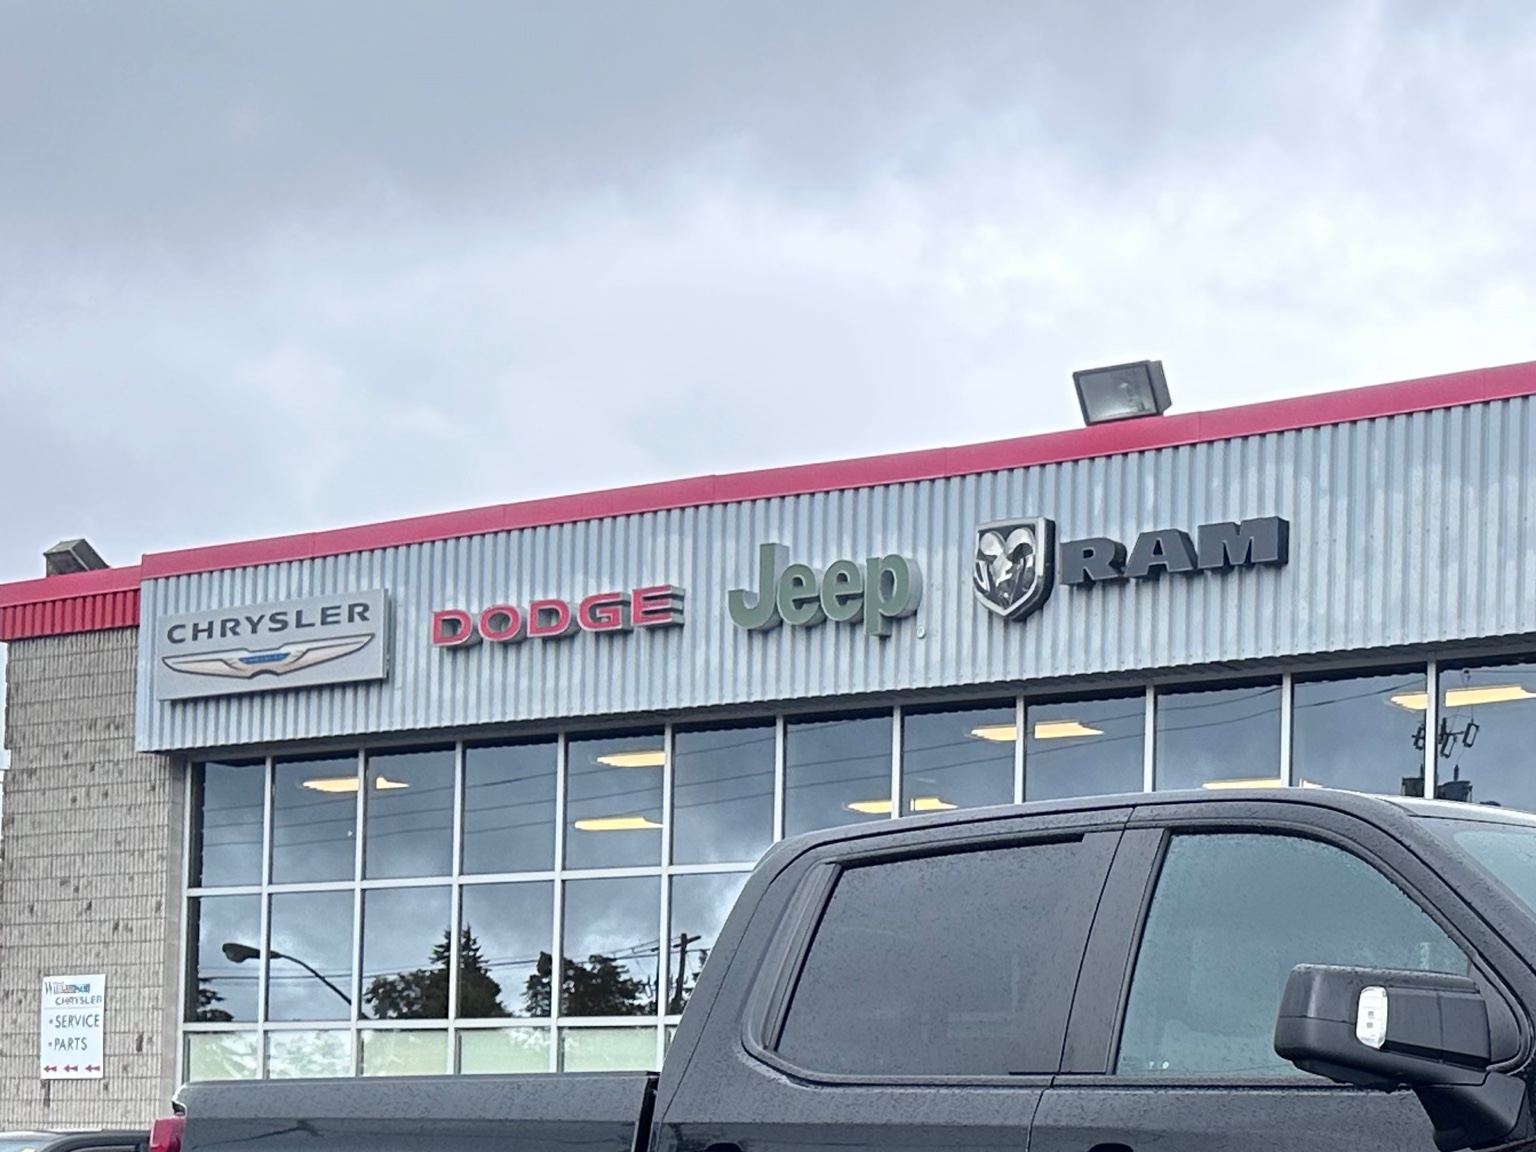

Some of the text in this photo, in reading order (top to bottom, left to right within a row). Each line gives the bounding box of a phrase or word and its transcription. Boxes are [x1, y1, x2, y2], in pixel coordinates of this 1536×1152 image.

[1060, 517, 1289, 587] RAM
[728, 543, 922, 637] Jeep
[167, 603, 370, 644] CHRYSLER
[432, 586, 684, 649] DODGE
[54, 1037, 87, 1051] PARTS
[55, 1014, 100, 1028] SERVICE
